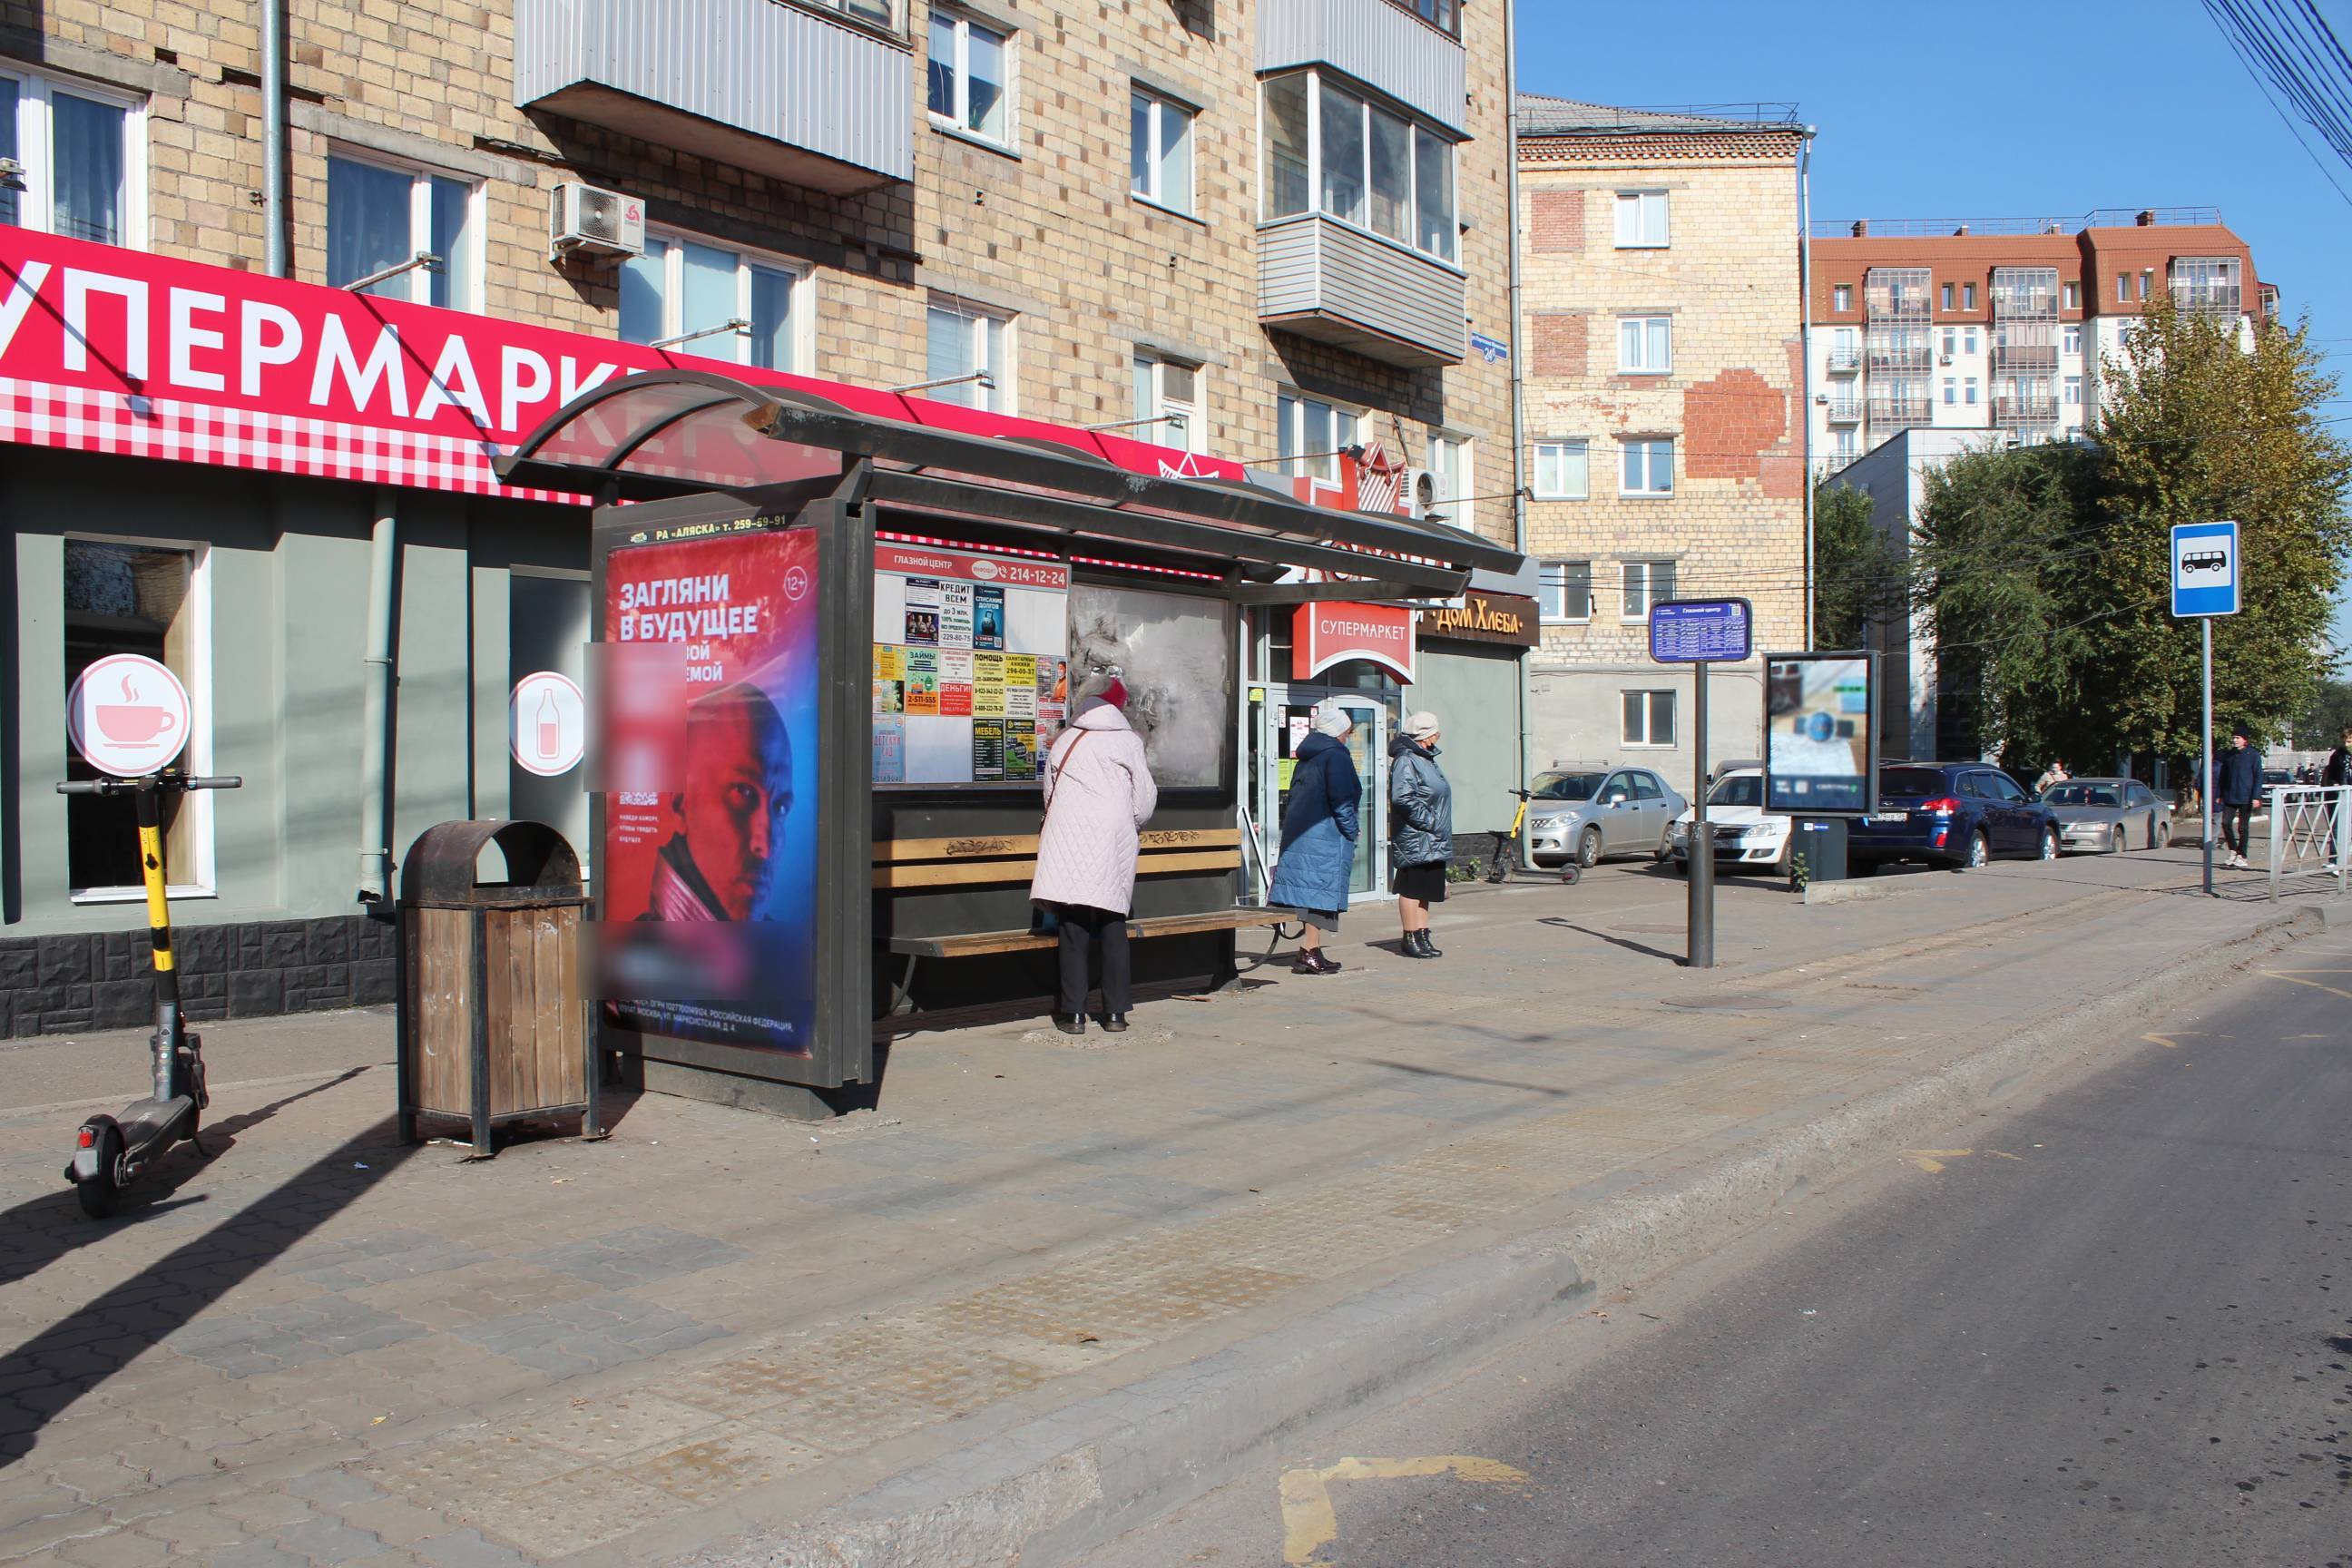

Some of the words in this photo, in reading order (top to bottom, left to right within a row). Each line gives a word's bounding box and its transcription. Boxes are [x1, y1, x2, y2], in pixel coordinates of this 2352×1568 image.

[656, 530, 669, 541] РА
[671, 524, 720, 538] «АЛЯСКА»
[722, 523, 731, 532] т.
[894, 554, 928, 567] ГЛАЗНОЙ
[929, 559, 953, 569] ЦЕНТР
[1010, 566, 1065, 585] 214-12-24
[788, 576, 806, 591] 12+
[941, 583, 971, 593] КРЕДИТ
[620, 573, 730, 610] ЗАГЛЯНИ
[946, 594, 967, 603] ВСЕМ
[621, 615, 634, 641] В
[641, 605, 758, 642] БУДУЩЕЕ
[1321, 620, 1406, 640] СУПЕРМАРКЕТ
[910, 651, 936, 661] ЗАЙМЫ
[975, 654, 1004, 663] ПОМОЩЬ
[940, 682, 972, 693] ДЕНЬГИ!
[907, 695, 936, 703] 2-511-555
[975, 727, 1002, 736] МЕБЕЛЬ
